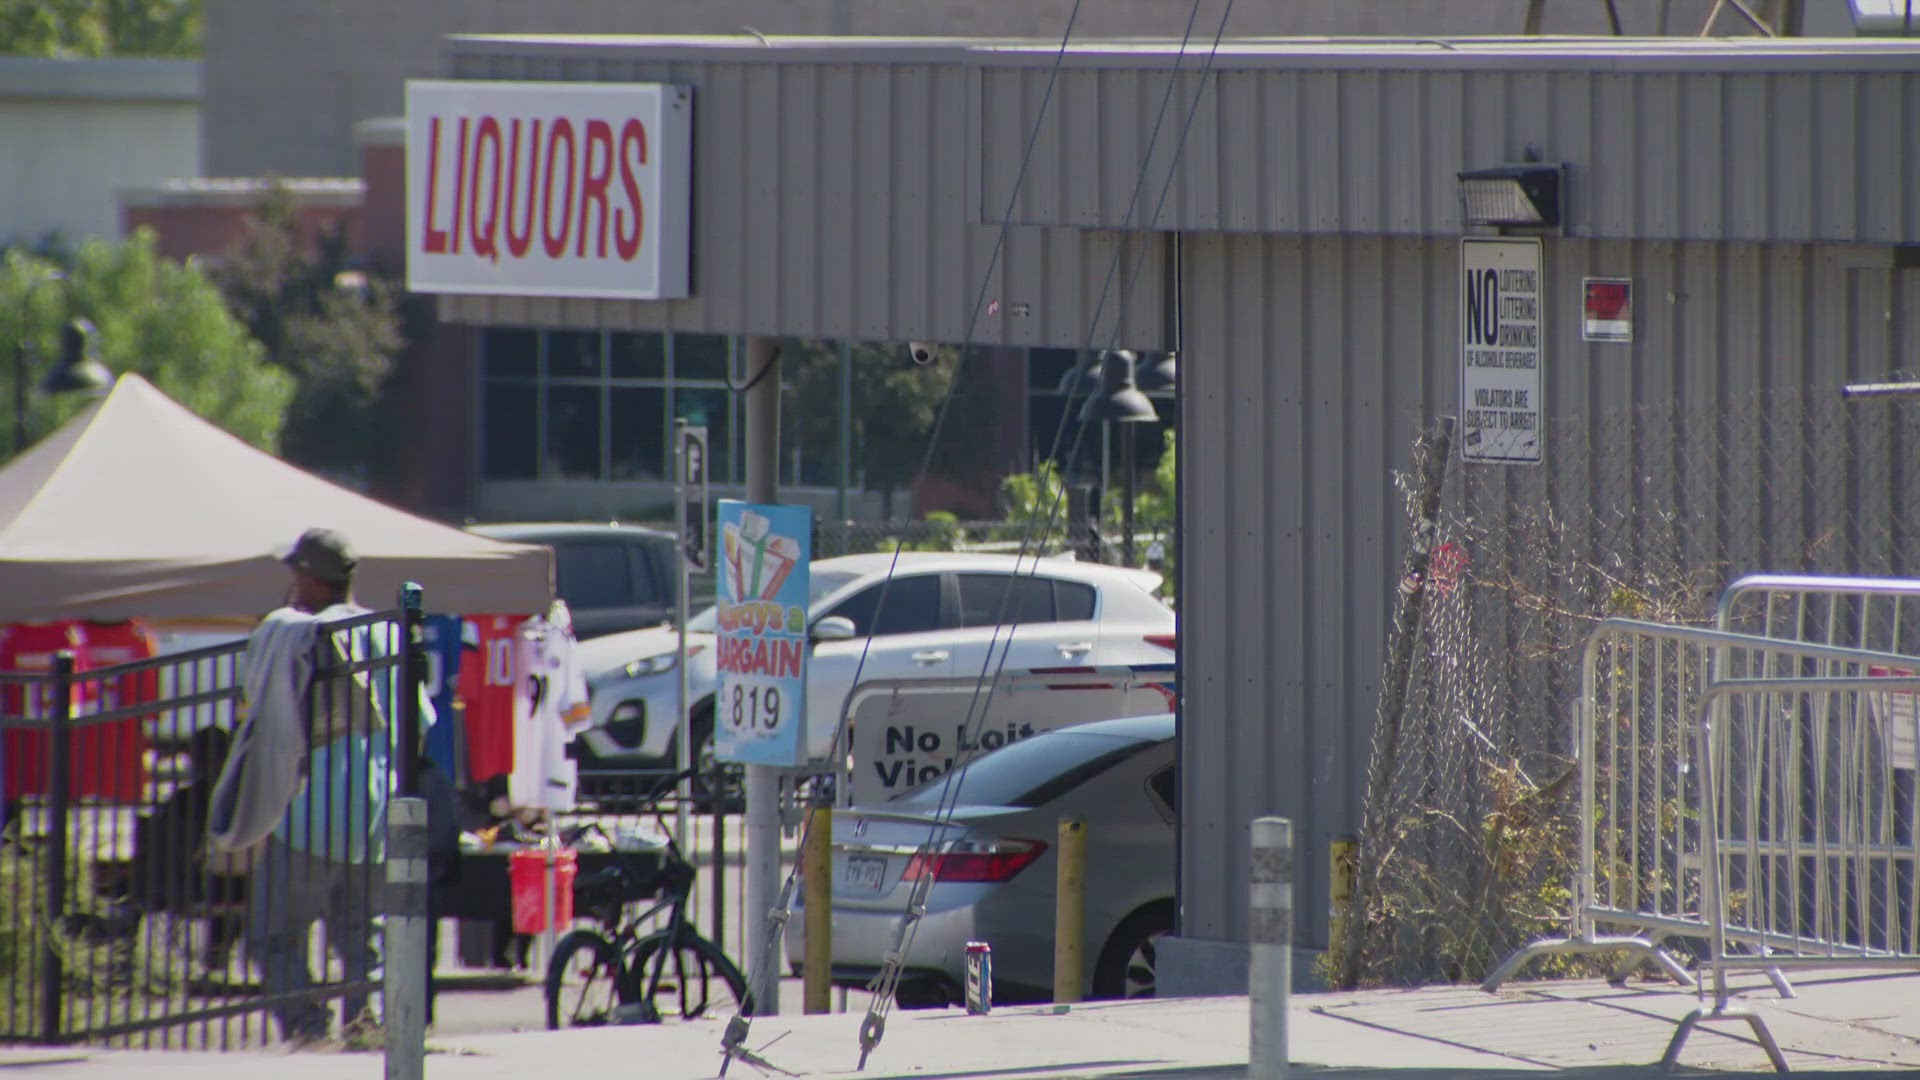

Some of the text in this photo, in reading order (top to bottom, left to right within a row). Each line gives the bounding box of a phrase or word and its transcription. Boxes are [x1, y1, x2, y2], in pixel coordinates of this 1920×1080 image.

[424, 116, 647, 263] LIQUORS
[1500, 269, 1536, 292] LOITERING
[1467, 268, 1498, 345] NO
[1500, 296, 1536, 320] LITTERING
[1500, 324, 1536, 348] DRINKING
[1467, 349, 1536, 369] OF ALCOHOLIC BEVERAGES
[1475, 389, 1528, 408] VIOLATORS ARE
[1499, 410, 1508, 429] TO
[1509, 411, 1536, 430] ARREST
[787, 607, 804, 633] a
[886, 722, 1051, 755] No Loit
